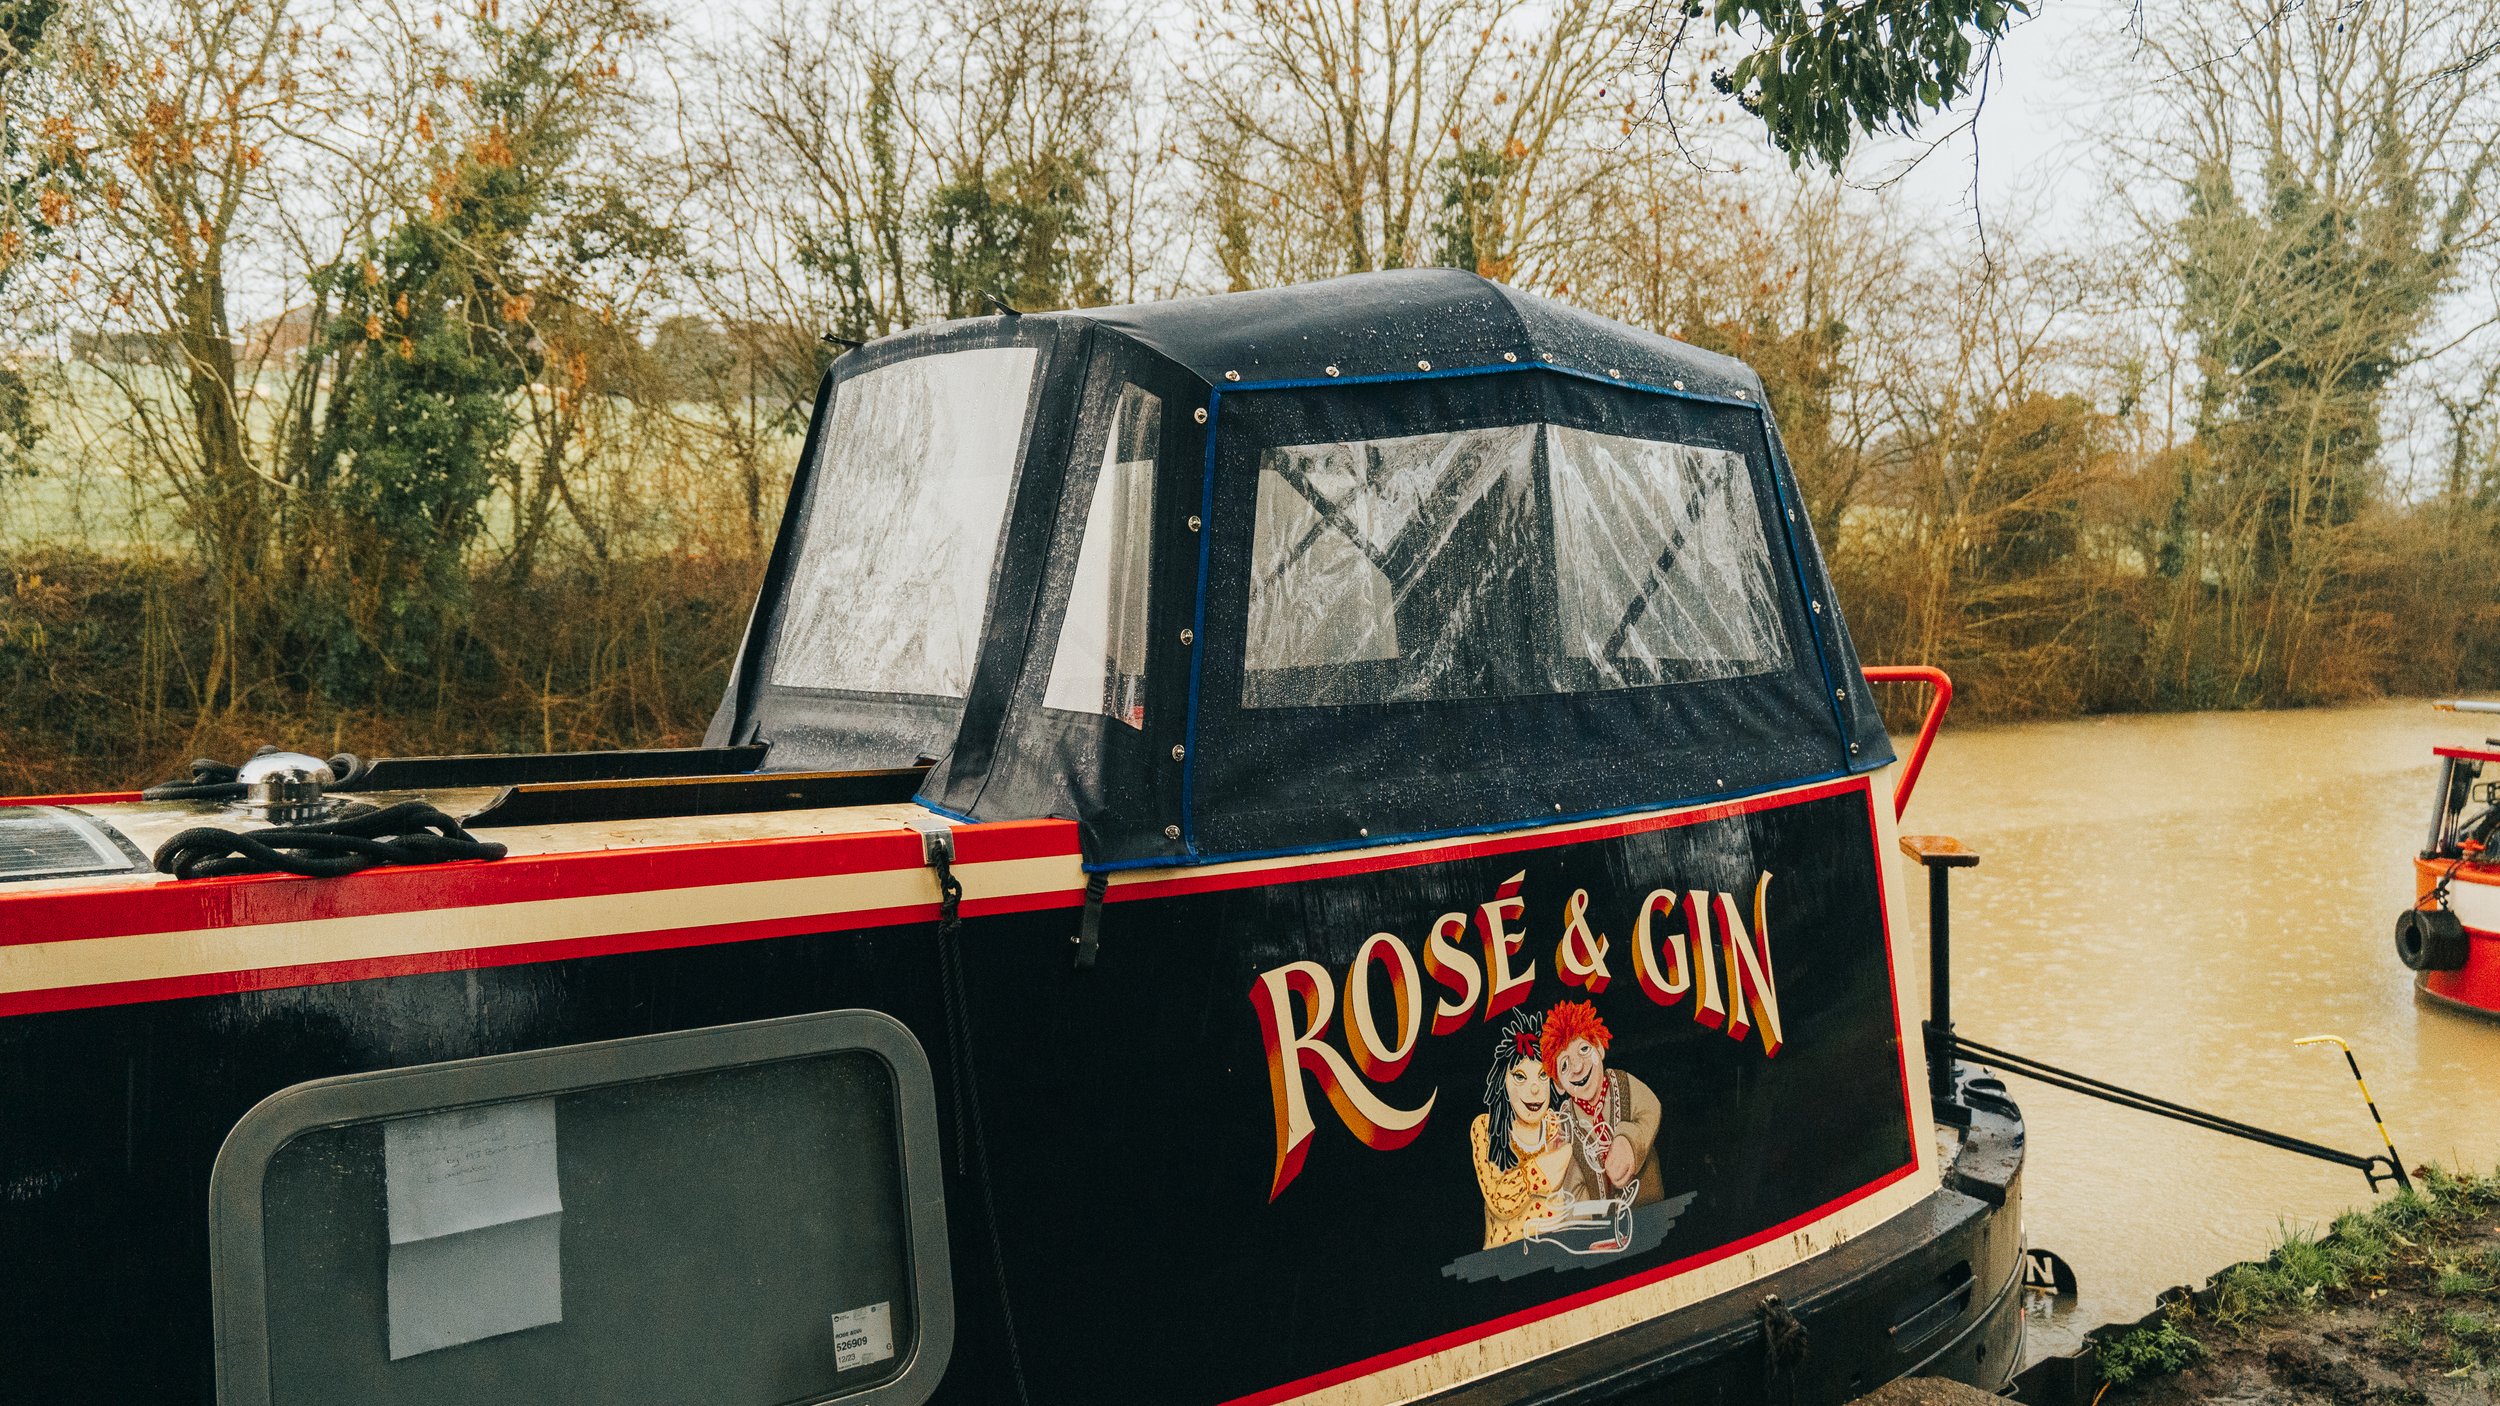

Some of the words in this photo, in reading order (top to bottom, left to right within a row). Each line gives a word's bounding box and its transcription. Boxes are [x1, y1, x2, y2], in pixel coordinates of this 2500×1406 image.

[1249, 869, 1536, 1204] ROSÉ
[1555, 888, 1613, 994] &
[1632, 870, 1784, 1059] GIN
[2026, 1254, 2055, 1285] N
[836, 1336, 868, 1352] 526909
[838, 1353, 856, 1364] 12/23
